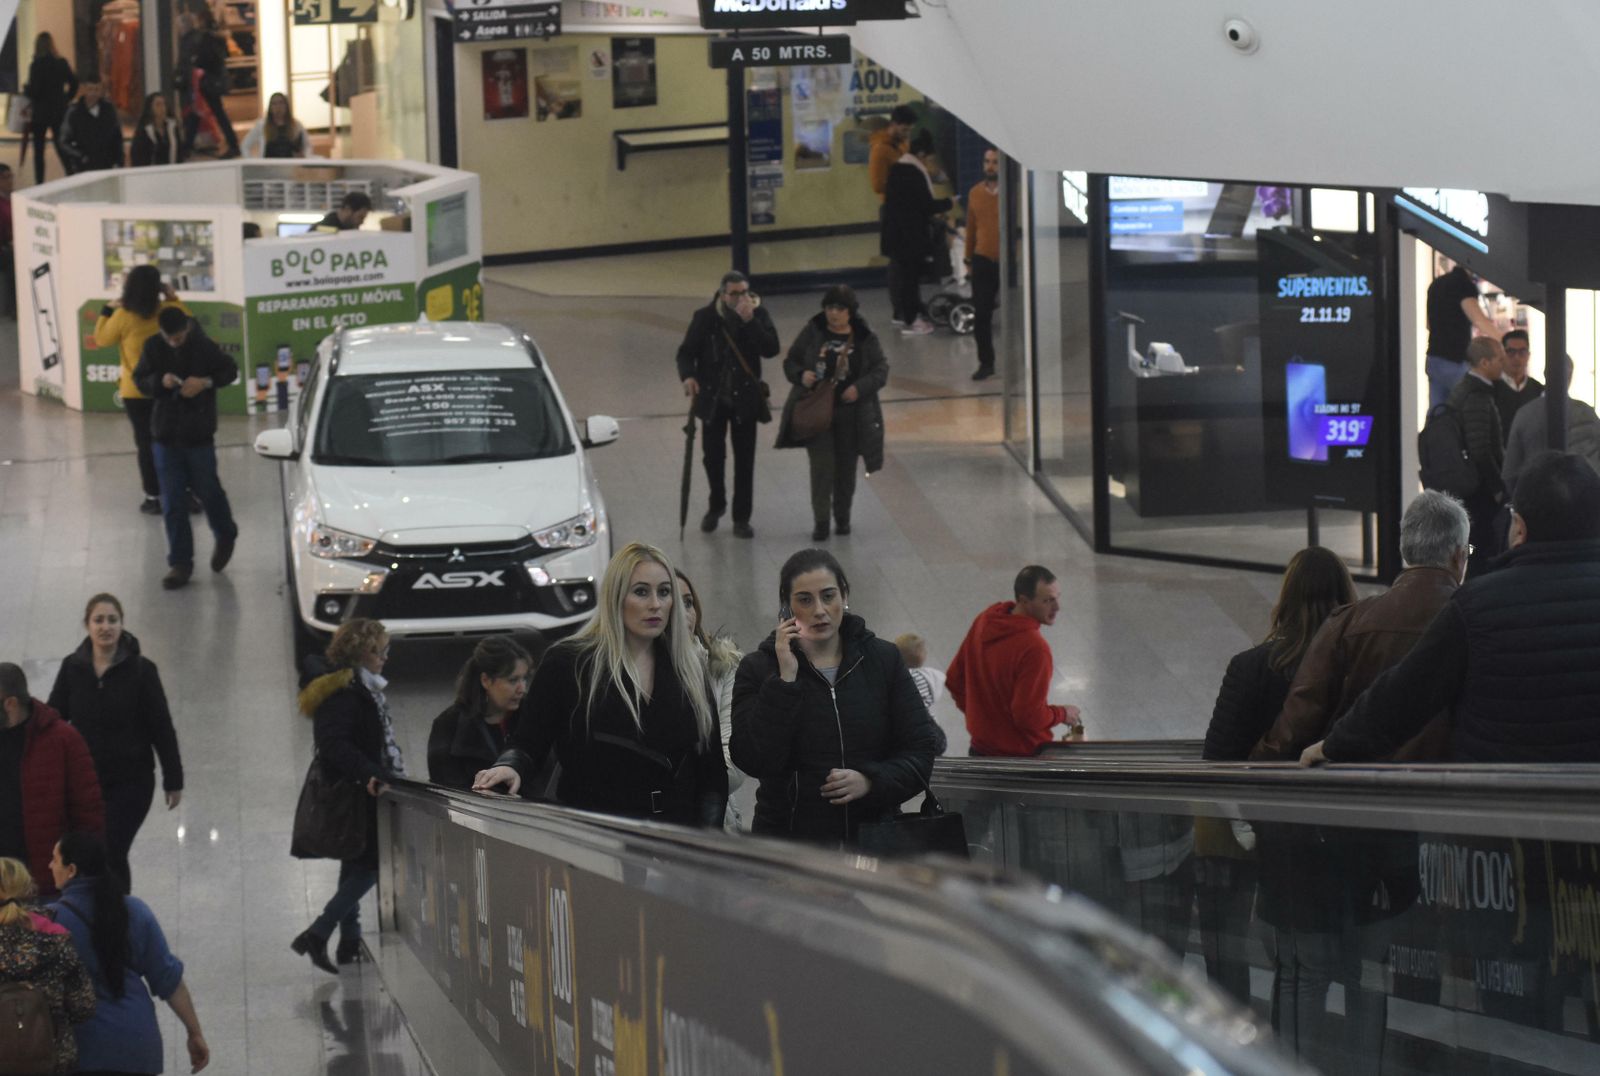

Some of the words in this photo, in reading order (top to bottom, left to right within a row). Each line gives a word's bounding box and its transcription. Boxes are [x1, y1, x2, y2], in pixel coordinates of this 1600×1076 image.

[731, 48, 744, 61] A
[752, 47, 771, 61] 50
[779, 45, 832, 59] MTRS.
[271, 248, 325, 277] BOLO
[331, 249, 388, 272] PAPA
[285, 271, 384, 288] www.bolopapa.com
[1277, 275, 1372, 298] SUPERVENTAS.
[257, 294, 338, 314] REPARAMOS
[341, 292, 359, 306] TU
[361, 287, 404, 304] MÓVIL
[292, 317, 311, 331] EN
[314, 316, 328, 329] EL
[331, 312, 367, 328] ACTO
[1300, 306, 1351, 323] 21.11.19
[408, 383, 445, 394] ASX
[423, 401, 450, 410] 150
[411, 570, 505, 590] ASX
